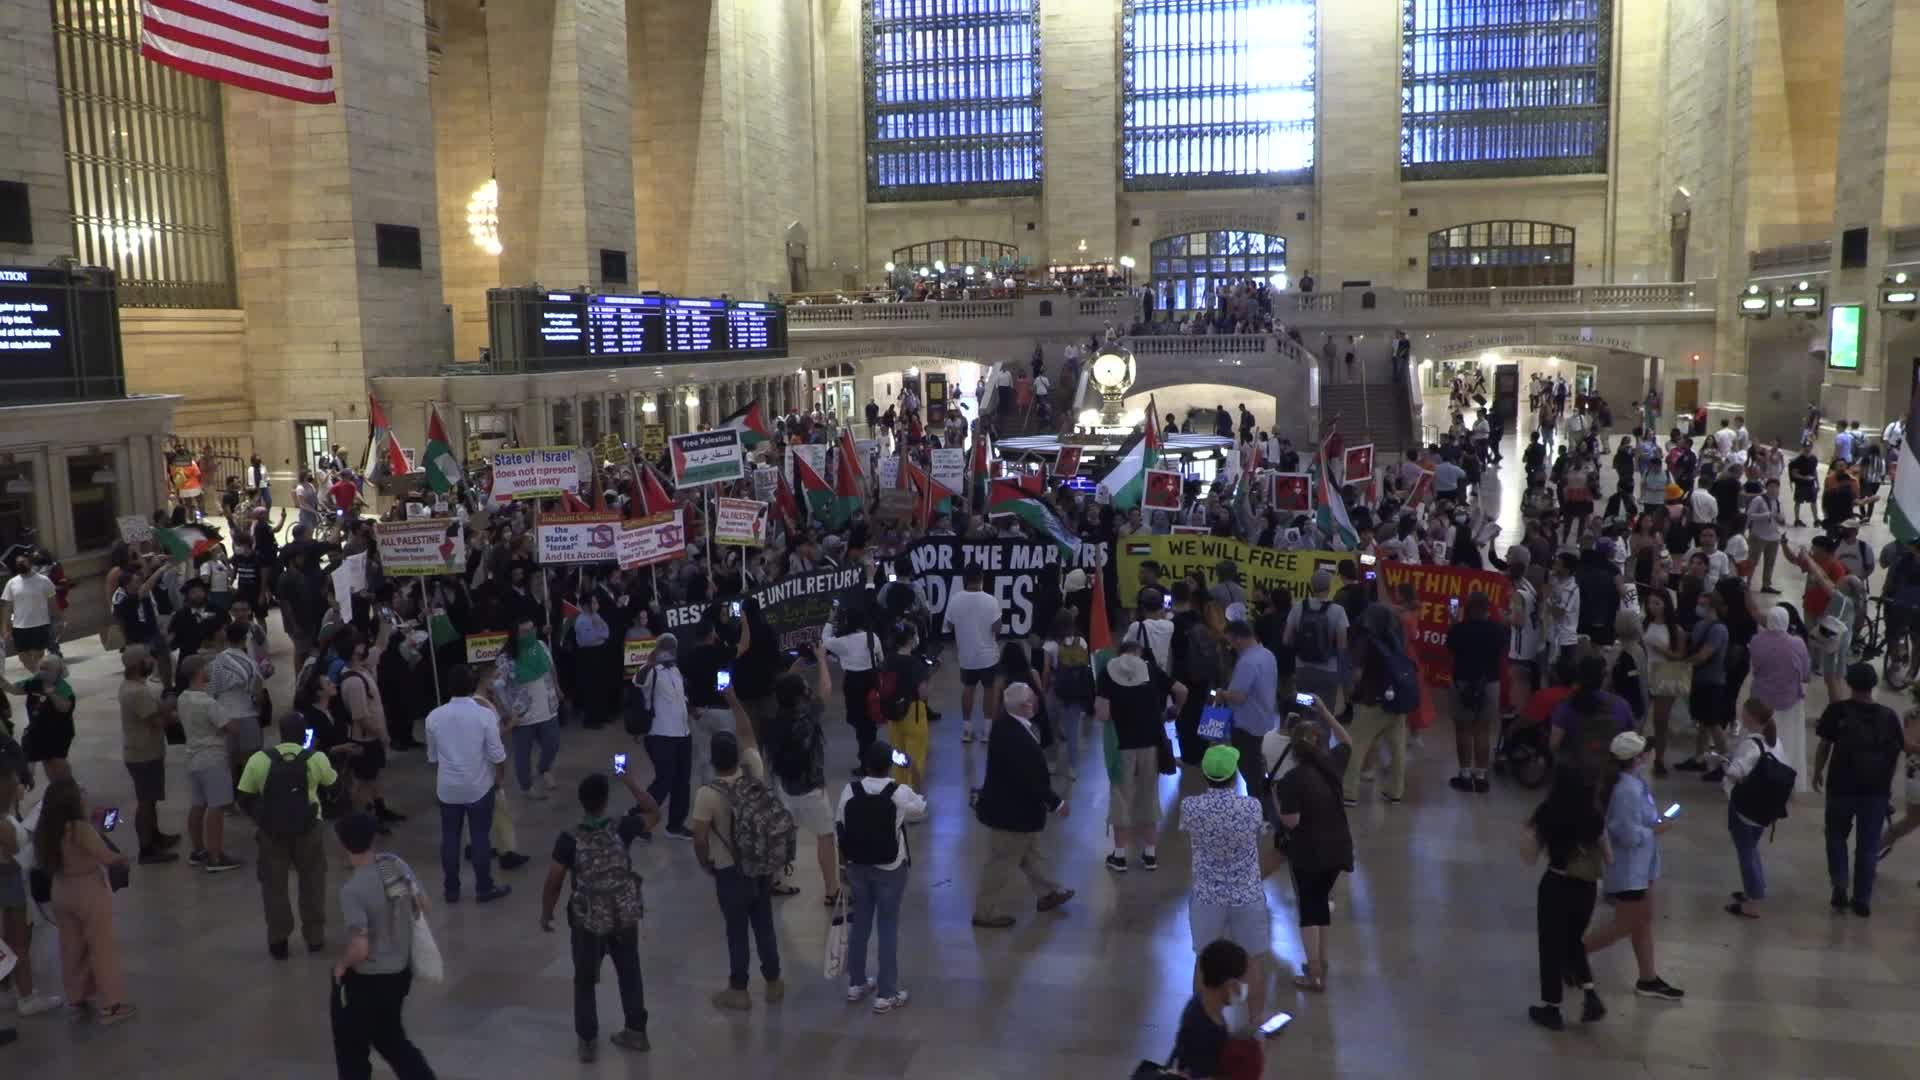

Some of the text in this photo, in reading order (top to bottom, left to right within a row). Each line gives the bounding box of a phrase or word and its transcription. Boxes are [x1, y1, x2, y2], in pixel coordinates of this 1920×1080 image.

[495, 453, 522, 466] State
[525, 449, 535, 463] of
[496, 469, 516, 479] does
[518, 466, 535, 477] not
[512, 477, 537, 488] world
[381, 535, 440, 546] ALL PALESTINE
[569, 533, 578, 542] of
[545, 552, 562, 561] And
[962, 544, 1003, 571] THE
[1168, 541, 1298, 572] WE WILL FREE
[767, 578, 805, 605] UNTIL
[806, 568, 861, 595] RETURN
